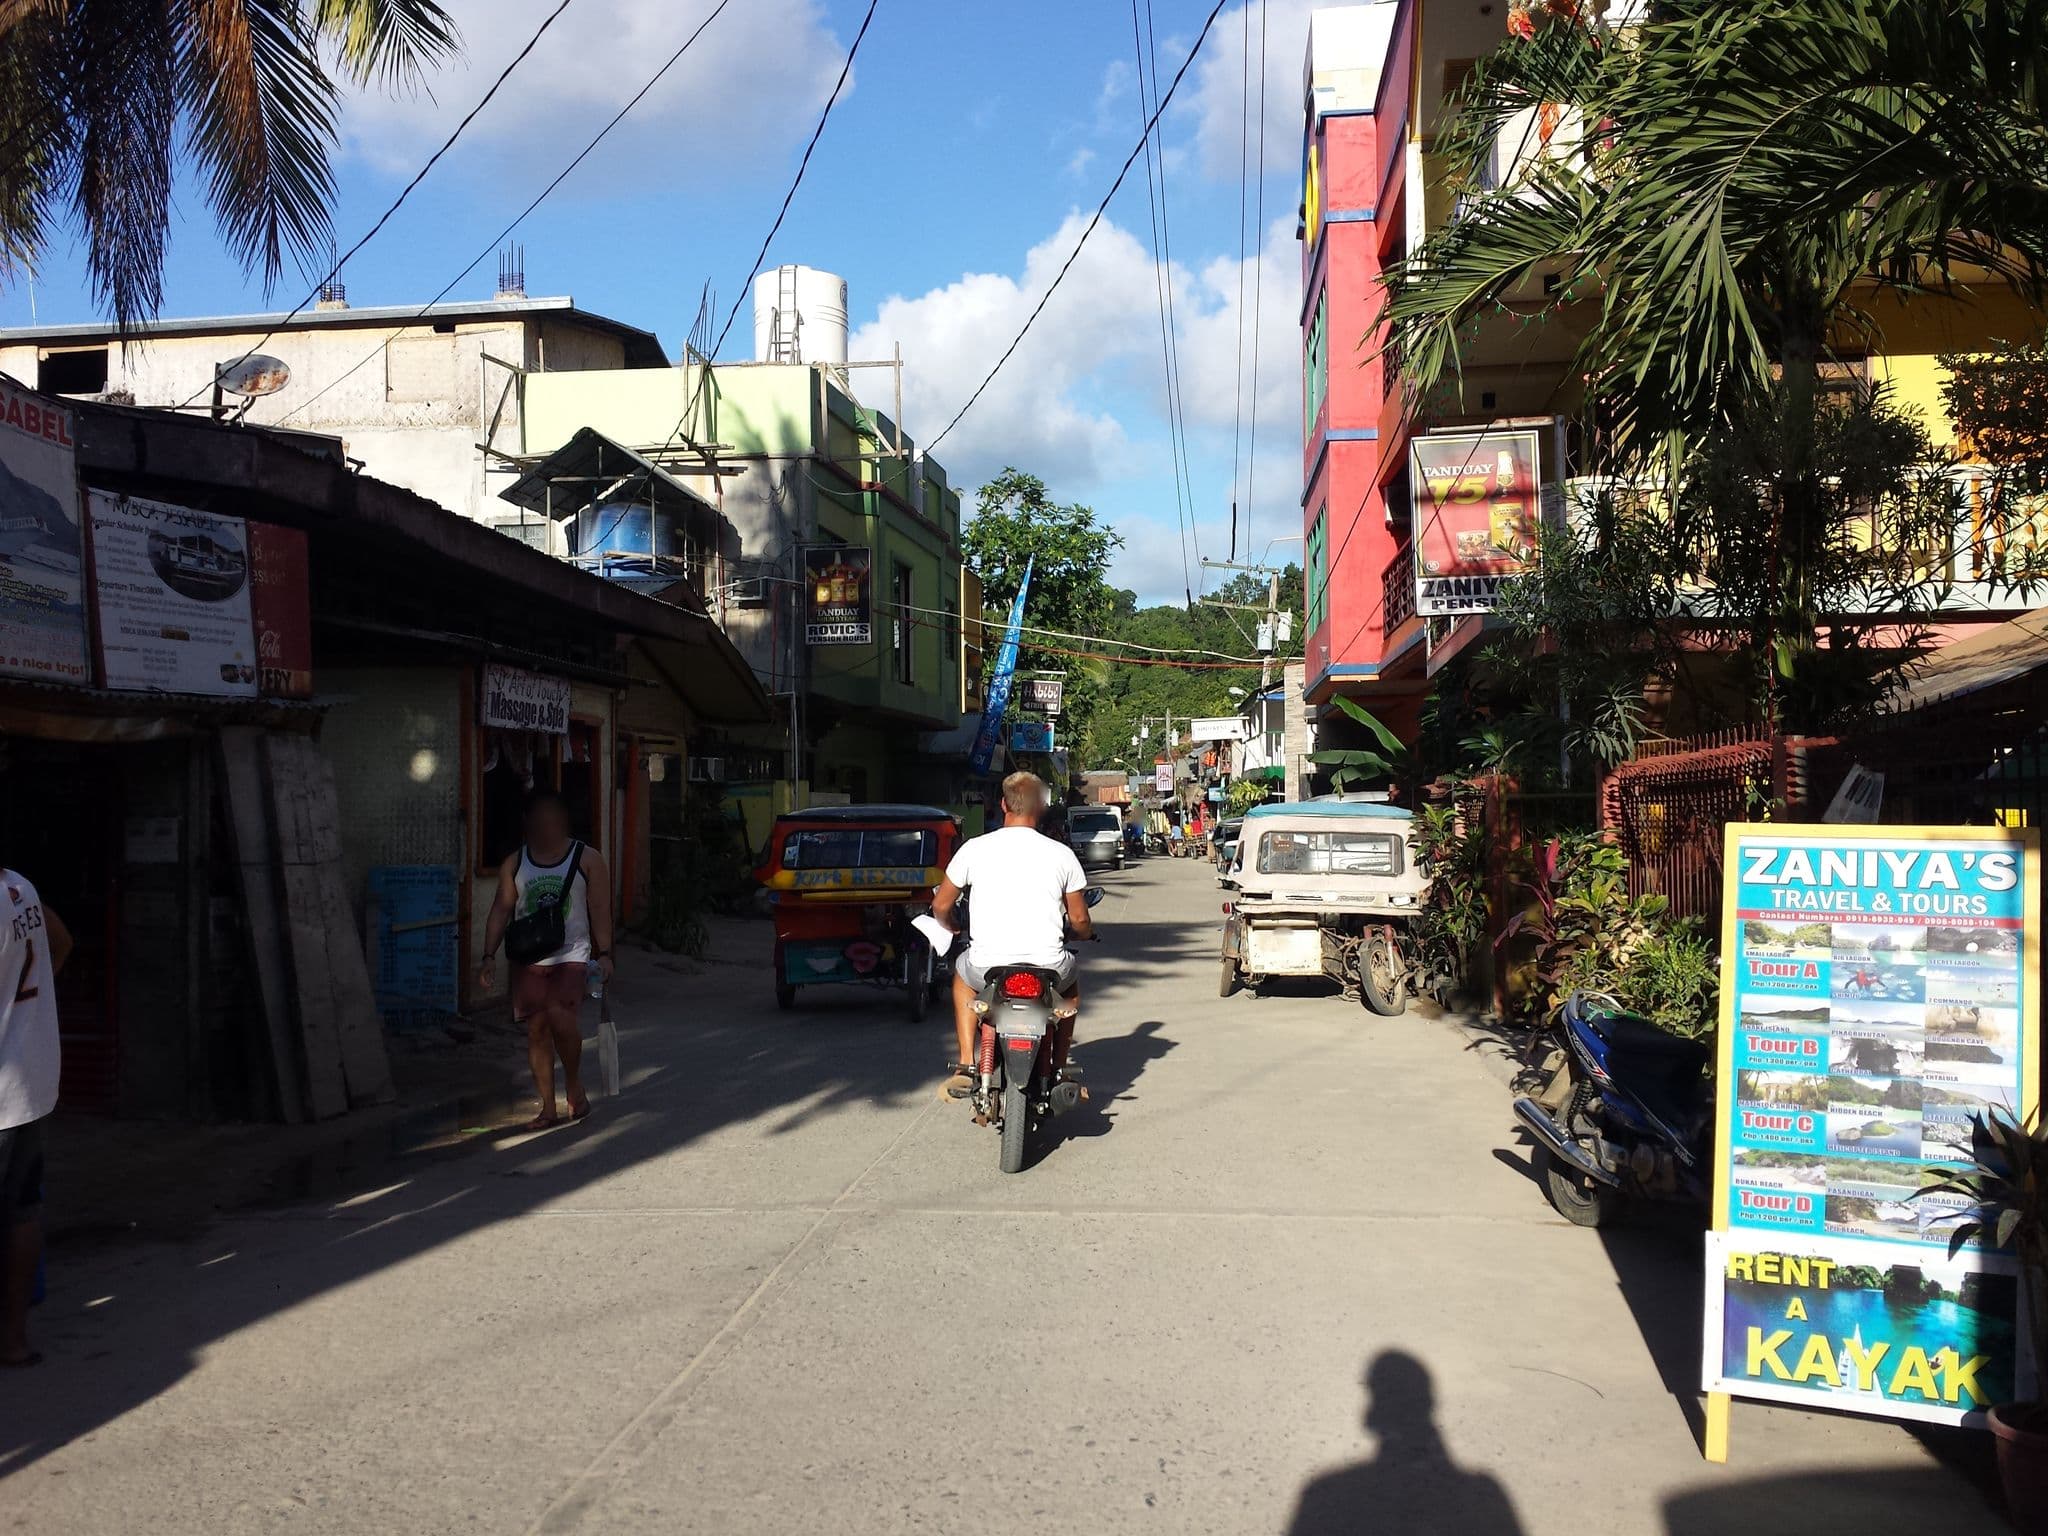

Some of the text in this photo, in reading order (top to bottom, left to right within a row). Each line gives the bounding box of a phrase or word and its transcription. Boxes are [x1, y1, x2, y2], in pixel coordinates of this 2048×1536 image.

[1422, 463, 1494, 476] TANDUAY
[817, 608, 859, 616] TANDUAY
[808, 624, 869, 636] ROVIC'S
[808, 635, 842, 643] PENSION
[10, 657, 18, 665] a
[23, 658, 52, 671] nice
[56, 661, 84, 676] trip!
[490, 690, 564, 730] Massage & Spa
[1742, 847, 2019, 891] ZANIYA'S
[1771, 888, 1988, 915] TRAVEL & TOURS
[1759, 911, 1797, 920] Contact
[1798, 913, 1843, 922] Numbers:
[1748, 959, 1819, 978] Tour A
[1933, 998, 1973, 1006] COMMANDO
[1747, 1036, 1818, 1055] Tour B
[1830, 1106, 1883, 1117] HIDDEN BEACH
[1742, 1112, 1813, 1132] Tour C
[1924, 1153, 1952, 1161] SECRET
[1759, 1180, 1783, 1189] BEACH
[1740, 1191, 1811, 1212] Tour D
[1727, 1251, 1837, 1289] RENT
[1785, 1297, 1809, 1322] A
[1746, 1326, 1993, 1407] KAYAK
